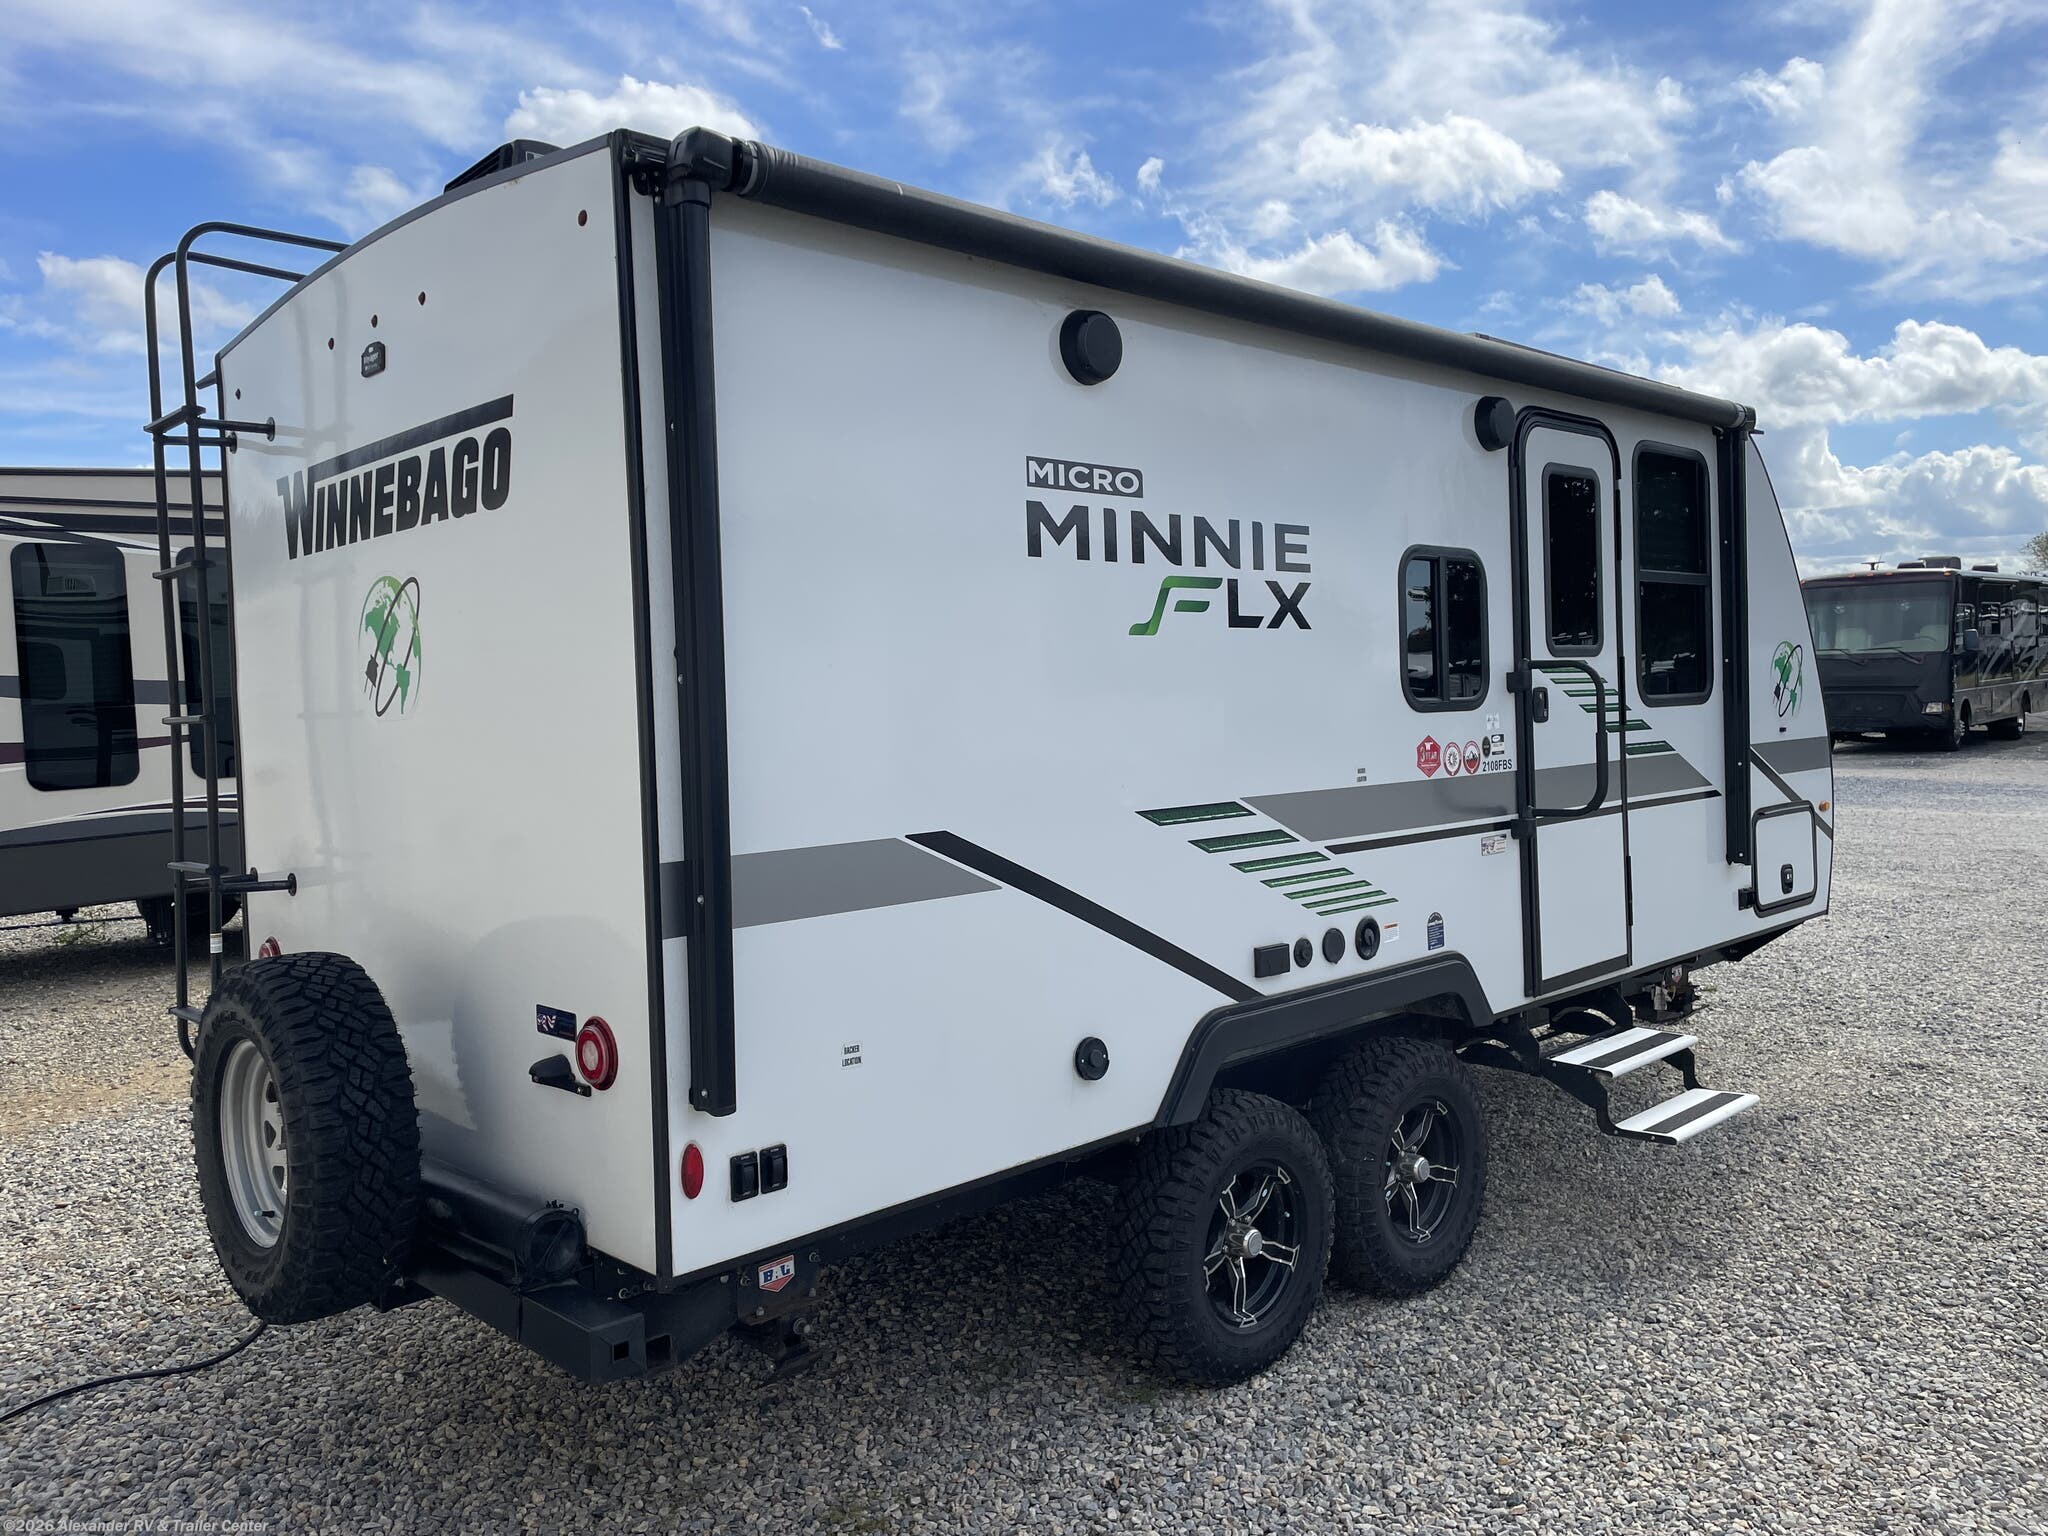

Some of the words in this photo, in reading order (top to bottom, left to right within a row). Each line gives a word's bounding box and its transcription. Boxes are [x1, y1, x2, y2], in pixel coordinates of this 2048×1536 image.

[276, 426, 513, 560] WINNEBAGO
[1028, 460, 1140, 494] MICRO
[1025, 500, 1311, 573] MINNIE
[1128, 575, 1312, 636] FLX
[1482, 758, 1513, 772] 2108FBS
